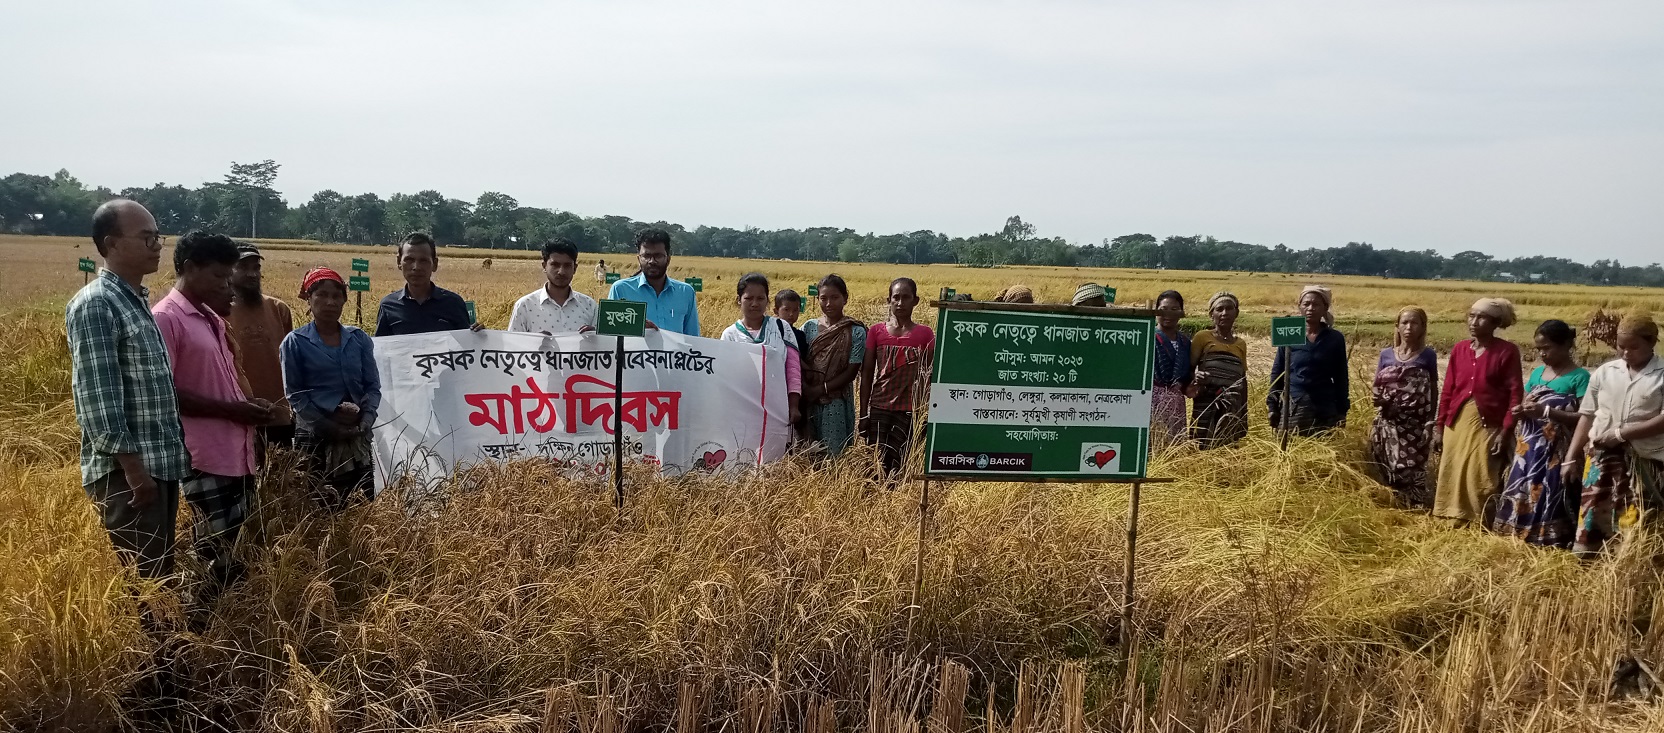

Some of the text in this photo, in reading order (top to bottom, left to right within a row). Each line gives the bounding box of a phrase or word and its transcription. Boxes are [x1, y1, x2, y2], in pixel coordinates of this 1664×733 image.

[605, 307, 638, 327] মুশুরী
[953, 320, 1142, 346] কৃষক নেতৃত্বে ধানজাত গবেষণা
[1276, 326, 1302, 337] আতব
[413, 349, 475, 378] কৃষক
[480, 349, 545, 376] নেতৃত্বে
[546, 350, 614, 371] ধানজাত
[615, 349, 674, 370] বেষনা
[994, 348, 1083, 367] মৌসুম: আমন ২০২৩
[997, 369, 1078, 384] জাত সংখ্যা: ২০ টি
[464, 374, 682, 436] মাঠ দিবস
[948, 388, 1132, 406] স্থান: গোড়াগাঁও, লেঙ্গুরা, কলমাকান্দা, নেত্রকোণা
[972, 408, 1018, 420] বাস্তবায়নে:
[1021, 407, 1051, 423] সূর্যমুখী
[1053, 408, 1076, 424] কৃষাণী
[1005, 427, 1059, 442] সহযোগিতায়:
[938, 453, 976, 466] বারসিক
[989, 457, 1025, 466] BARCIK
